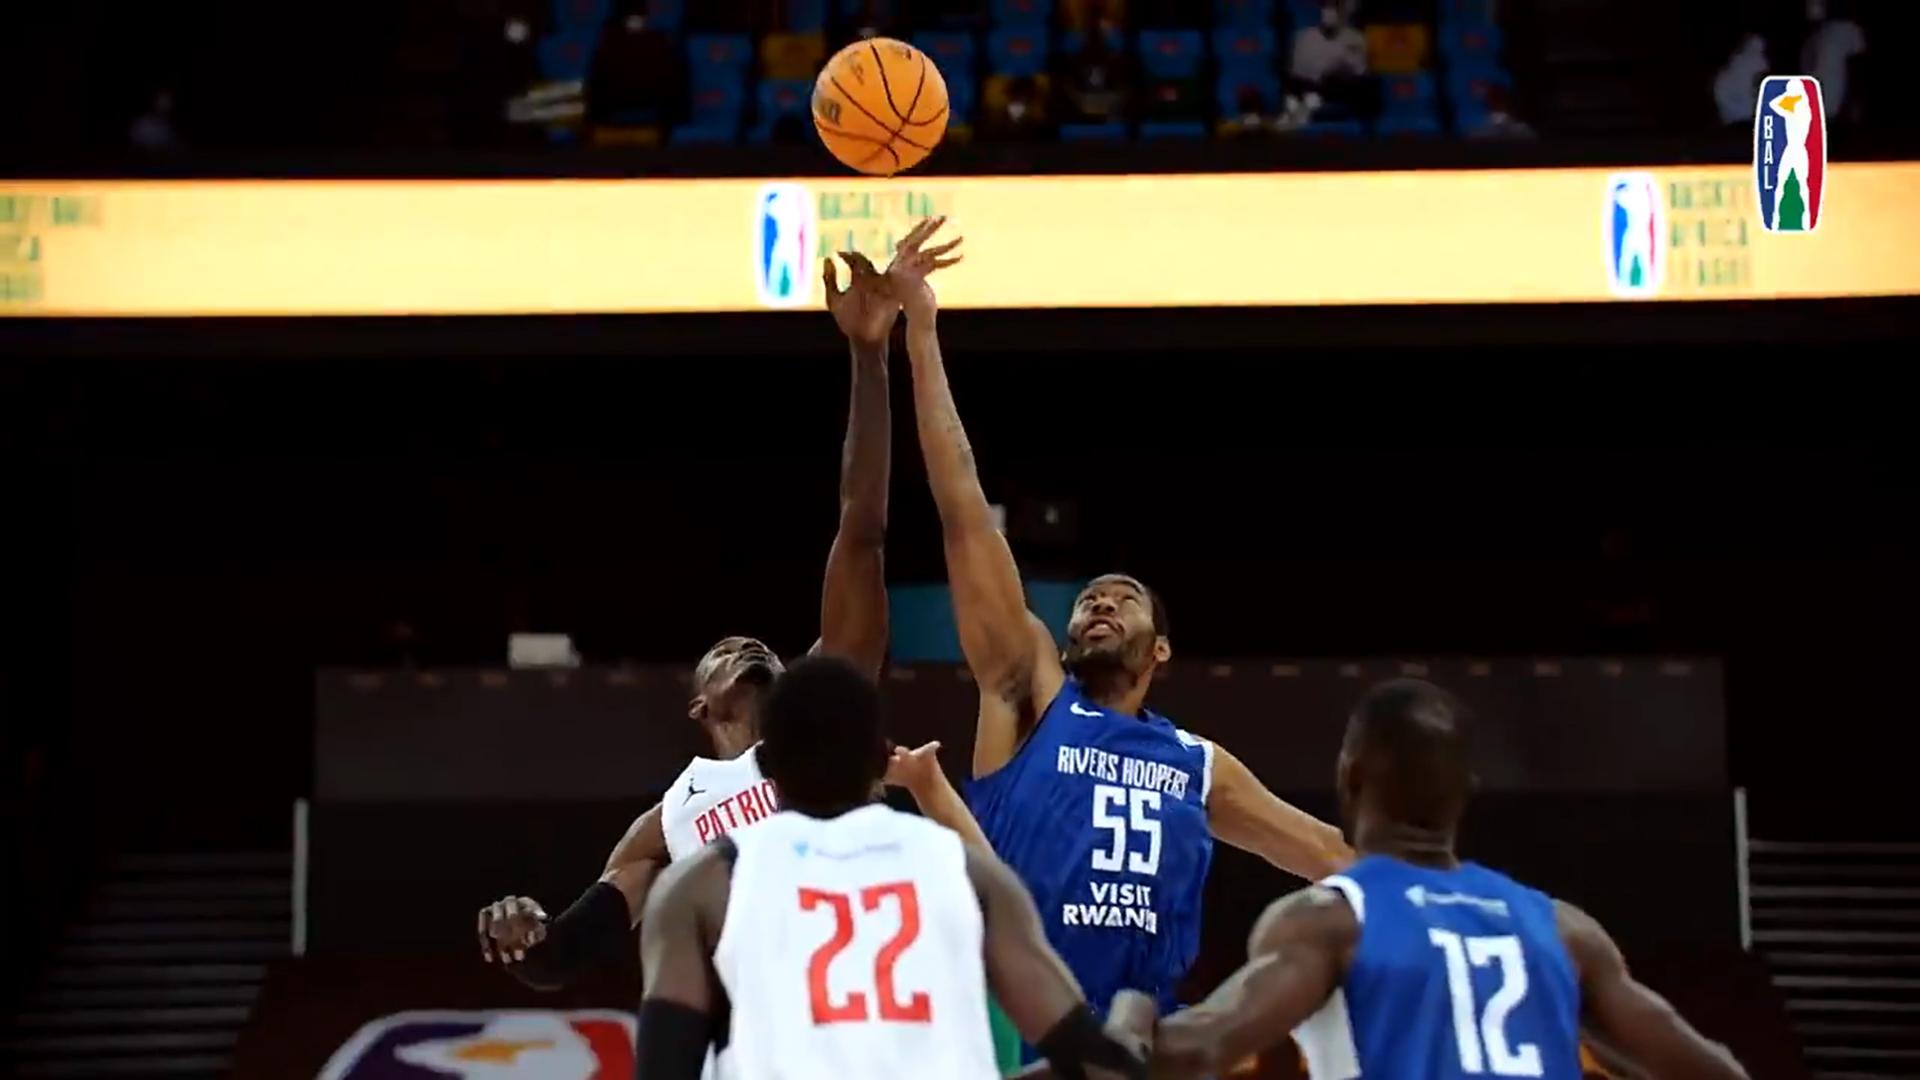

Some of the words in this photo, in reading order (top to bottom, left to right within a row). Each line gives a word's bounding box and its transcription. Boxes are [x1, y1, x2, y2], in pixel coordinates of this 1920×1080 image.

[1057, 745, 1119, 783] RIVERS
[1122, 756, 1190, 800] HOOPERS
[1092, 784, 1162, 876] 55
[1089, 881, 1152, 907] VISIT
[798, 881, 932, 1026] 22
[1427, 927, 1544, 1078] 12
